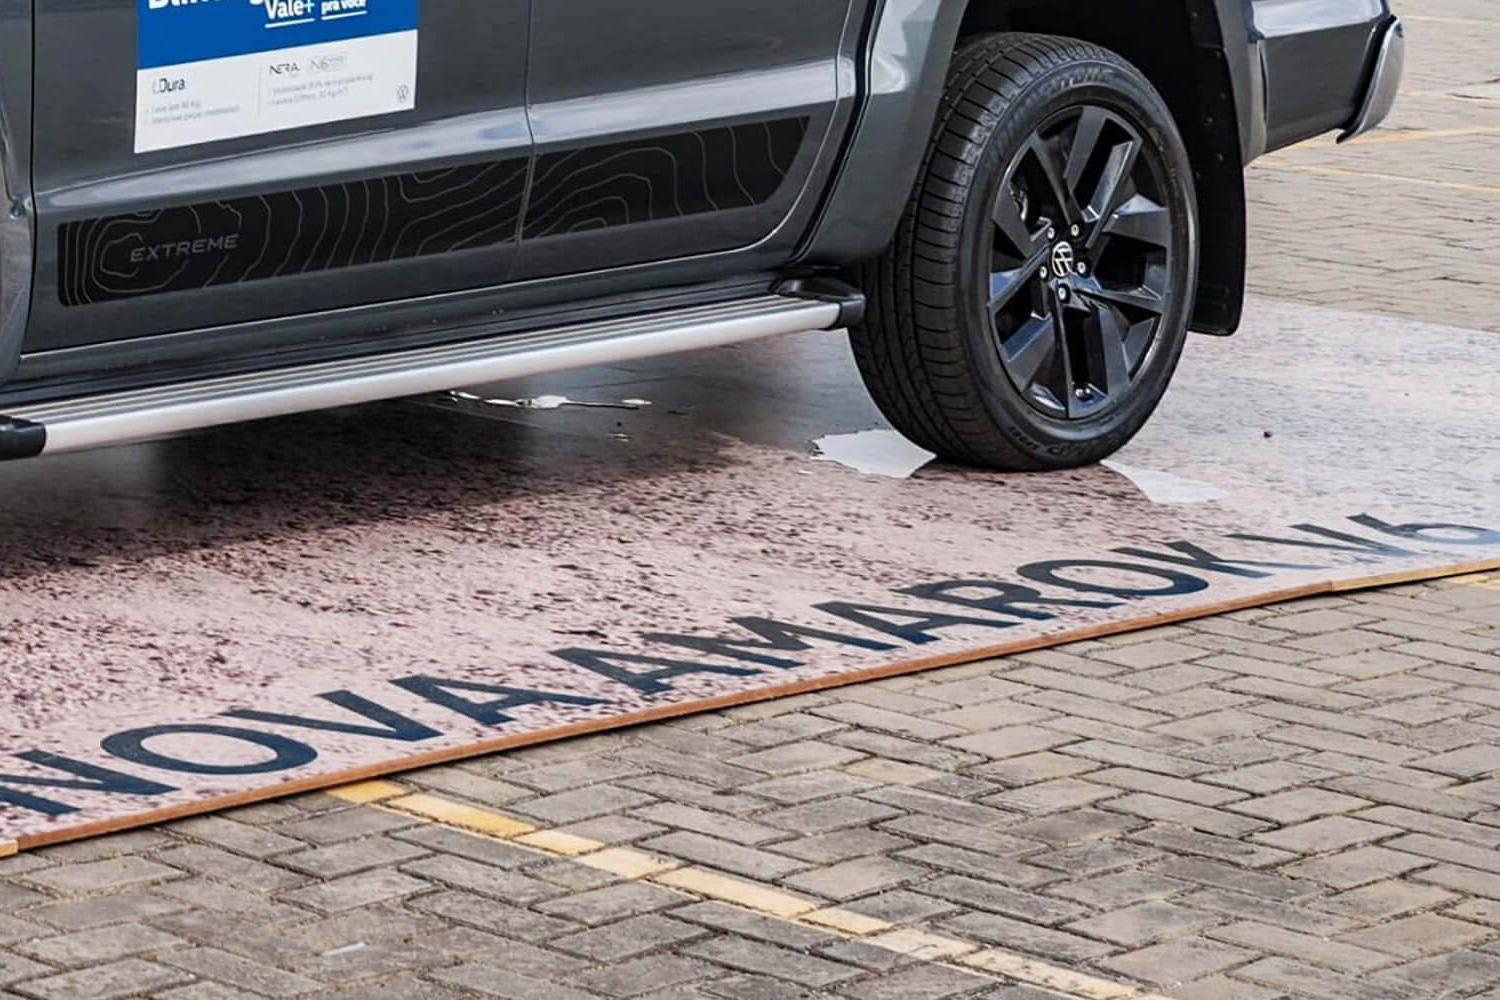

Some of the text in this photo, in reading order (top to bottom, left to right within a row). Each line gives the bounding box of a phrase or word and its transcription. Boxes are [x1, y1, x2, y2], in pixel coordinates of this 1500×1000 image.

[321, 0, 340, 15] pra
[130, 234, 239, 262] EXTREME
[550, 540, 1331, 694] AMAROK
[1225, 513, 1500, 557] V6
